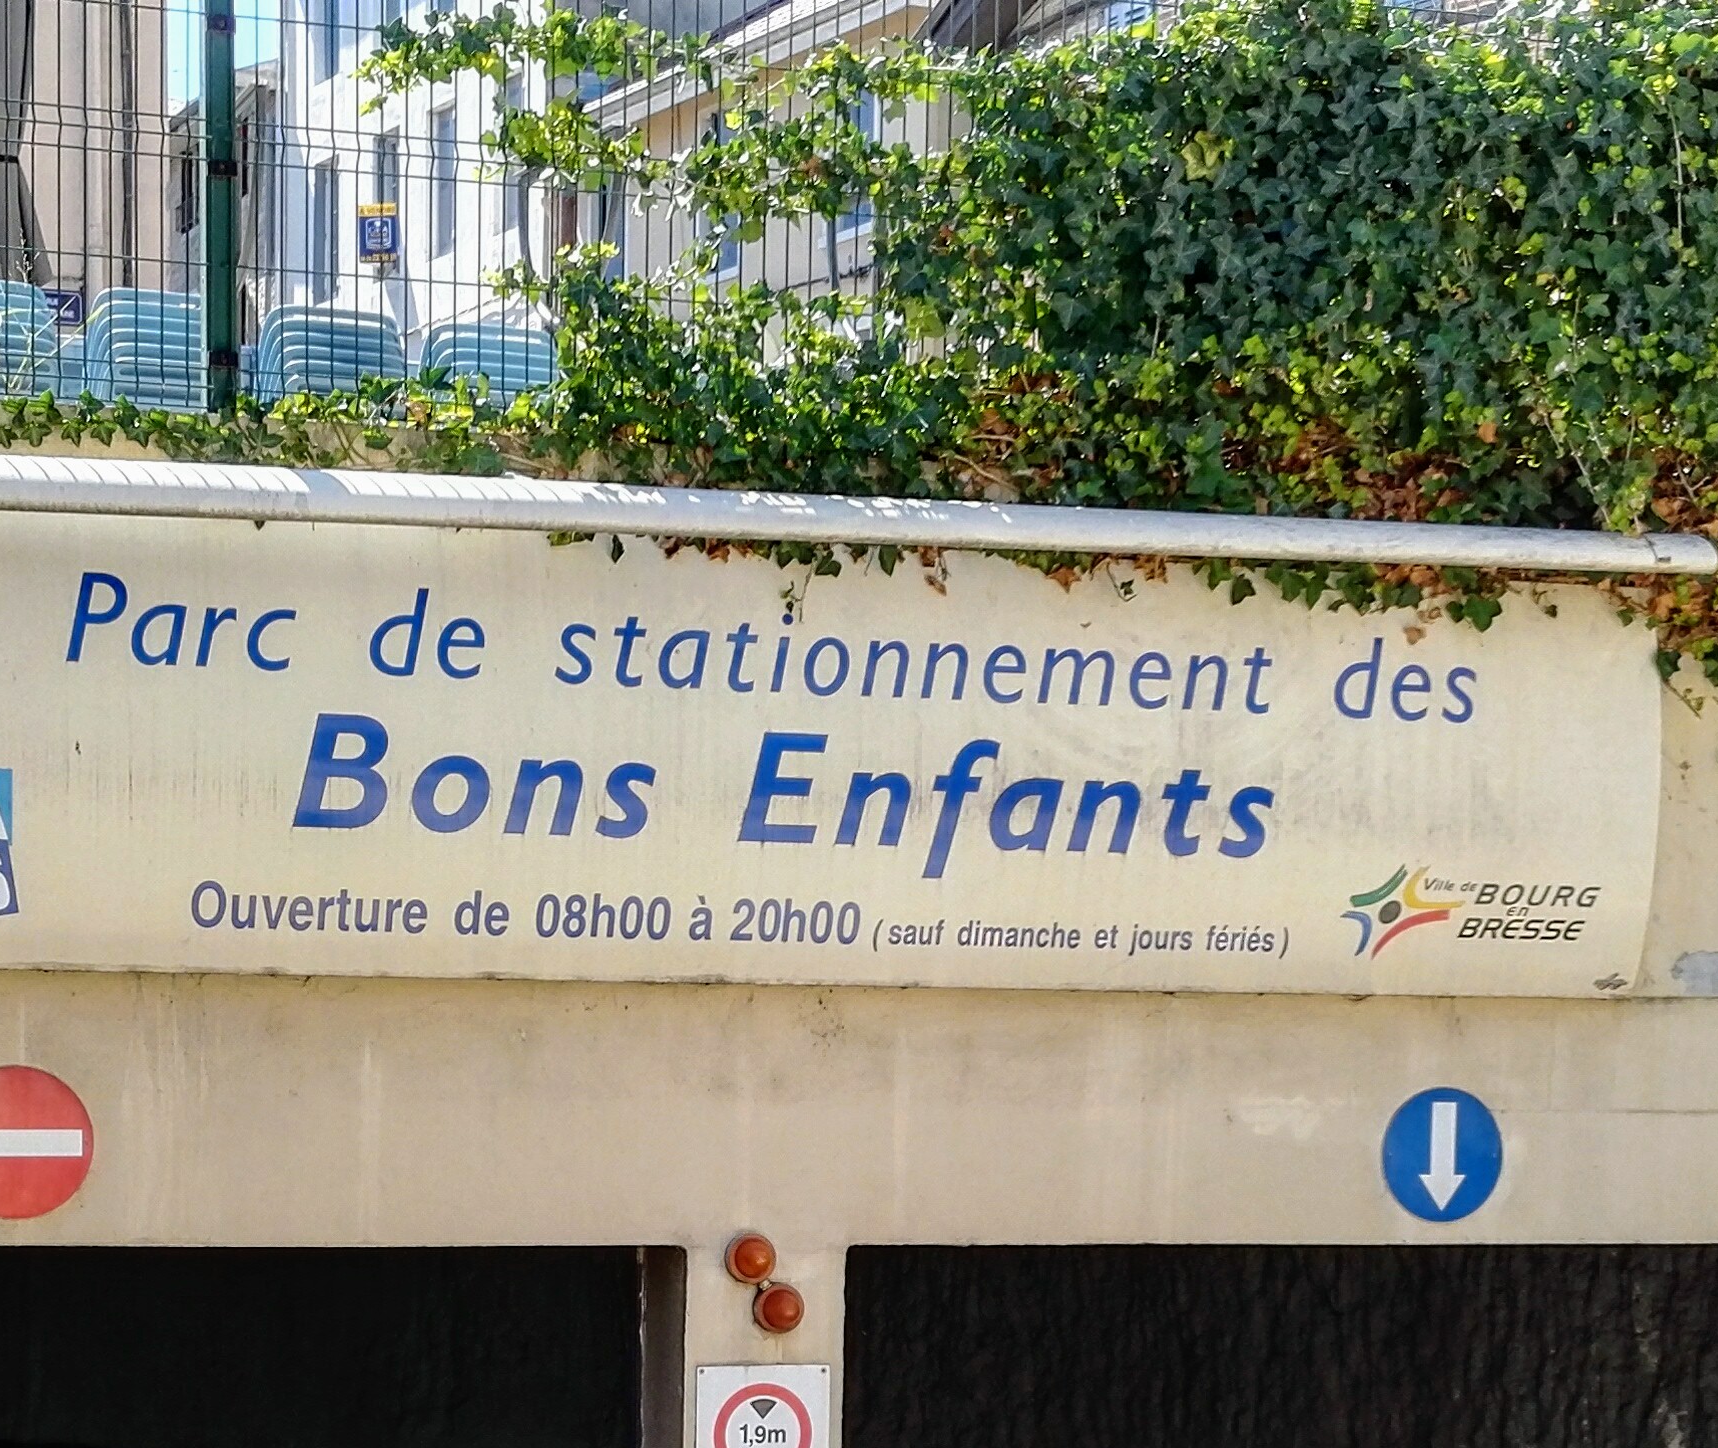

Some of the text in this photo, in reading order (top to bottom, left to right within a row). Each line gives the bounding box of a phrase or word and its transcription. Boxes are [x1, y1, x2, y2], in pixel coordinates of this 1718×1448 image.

[66, 571, 1479, 725] Parc de stationnement des
[291, 712, 1276, 879] Bons Enfants
[1424, 876, 1602, 908] Ville de BOURG
[190, 880, 428, 935] Ouverture
[454, 890, 510, 937] de
[535, 893, 673, 941] 08h00
[688, 895, 713, 941] à
[729, 897, 862, 945] 20h00
[956, 919, 1082, 950] dimanche
[1094, 924, 1120, 950] et
[1128, 923, 1194, 956] jours
[1506, 905, 1530, 917] en
[1456, 917, 1586, 941] BRESSE
[739, 1423, 787, 1447] 1,9m
